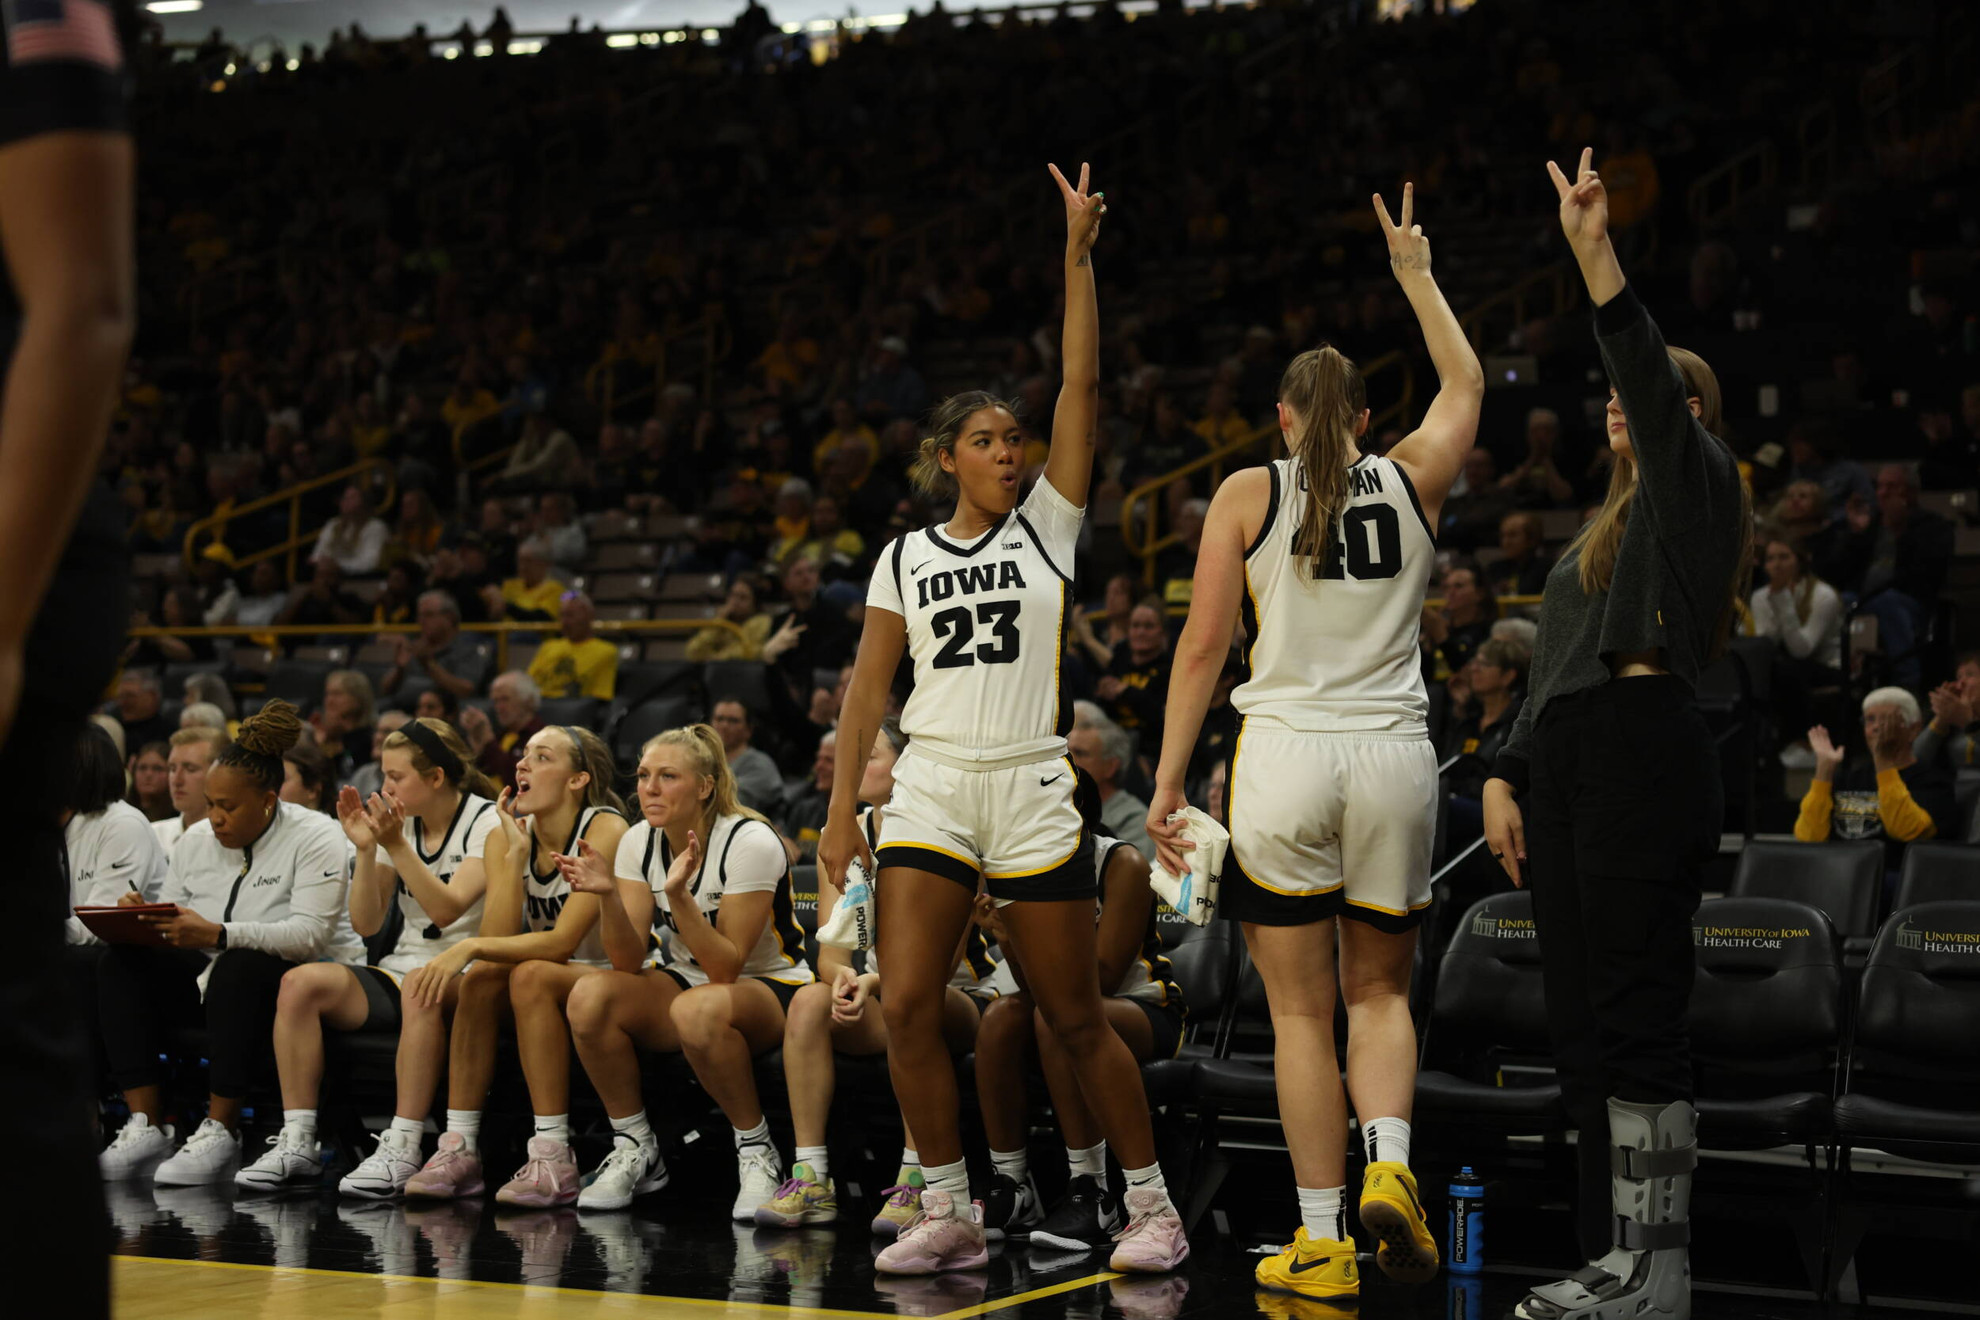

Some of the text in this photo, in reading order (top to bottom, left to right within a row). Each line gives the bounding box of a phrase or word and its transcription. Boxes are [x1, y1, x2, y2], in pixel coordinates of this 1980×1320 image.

[1291, 503, 1402, 580] 40
[917, 561, 1026, 609] IOWA
[931, 600, 1020, 669] 23
[856, 906, 867, 948] POWER
[1499, 918, 1536, 928] UNIVE
[1781, 928, 1811, 939] IOWA
[1925, 930, 1980, 943] UNIVERSI
[1704, 937, 1783, 949] HEALTH CARE
[1924, 941, 1974, 953] HEALTH
